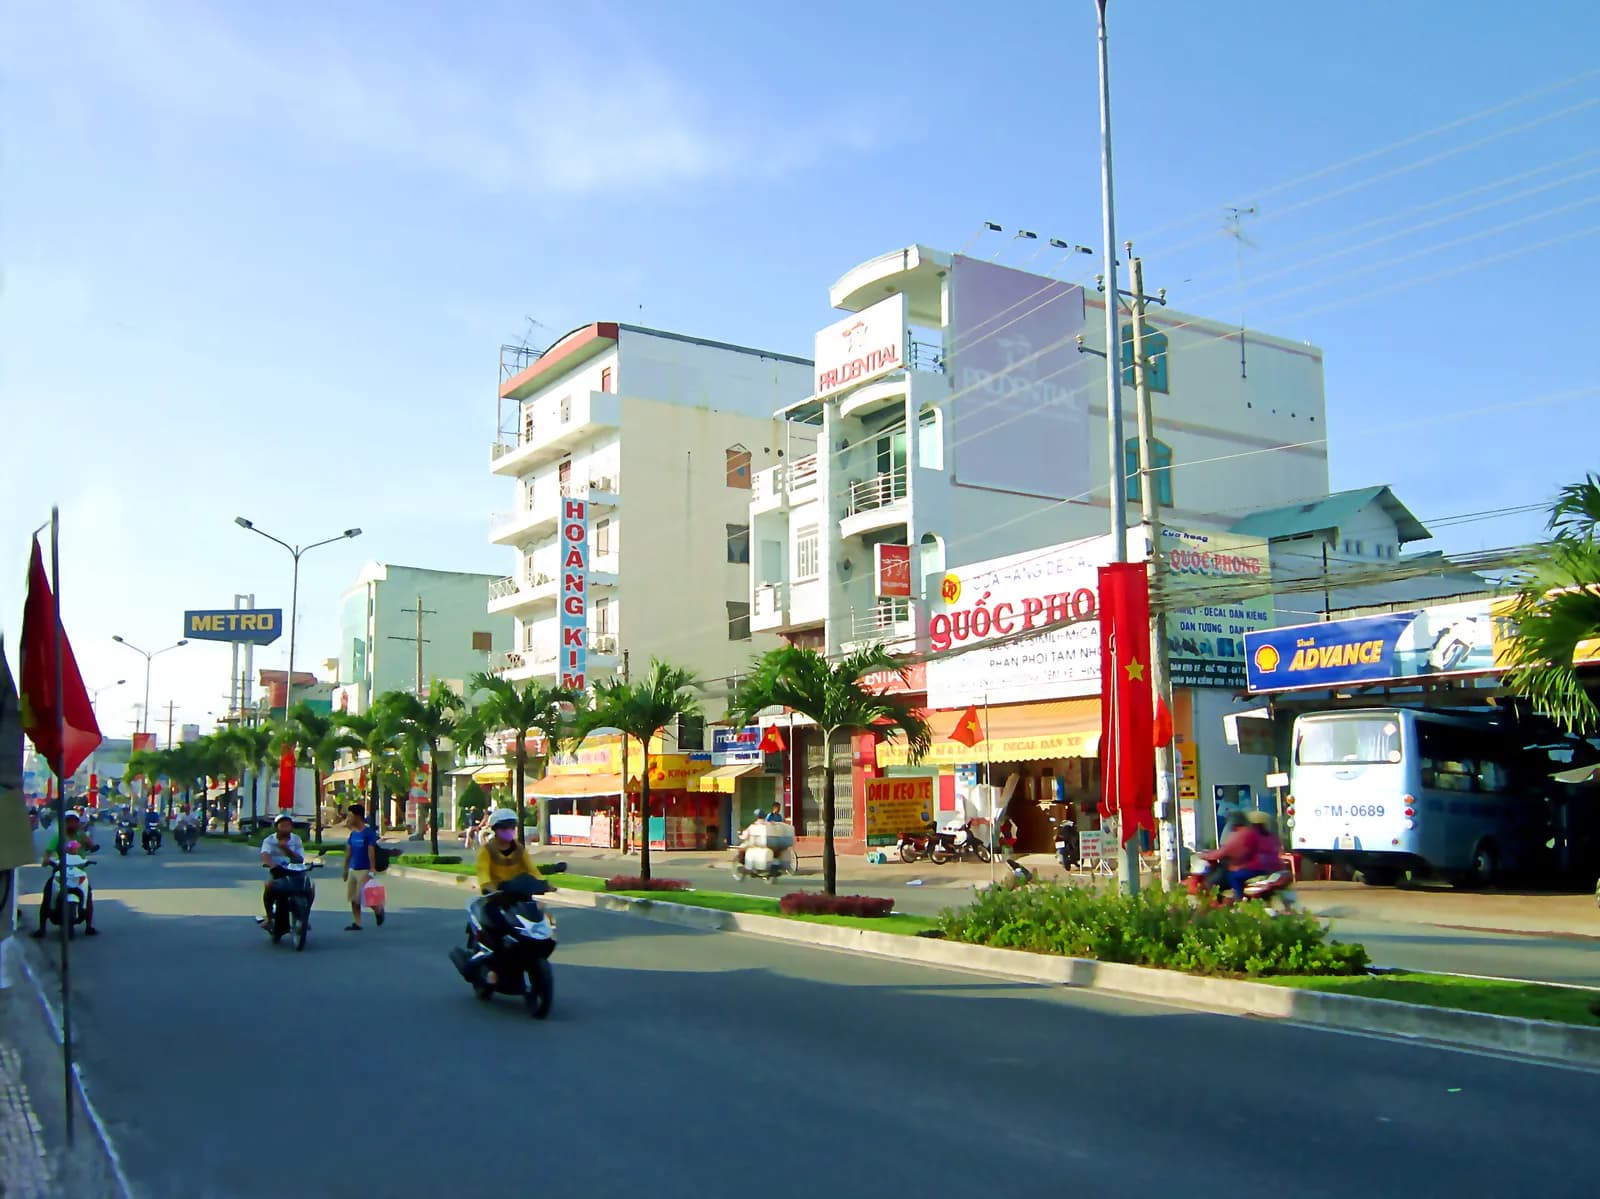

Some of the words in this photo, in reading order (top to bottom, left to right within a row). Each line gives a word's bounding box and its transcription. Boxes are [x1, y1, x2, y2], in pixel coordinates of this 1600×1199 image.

[819, 343, 899, 393] PRUDENTIAL
[564, 501, 585, 616] HOÀNG
[1213, 553, 1261, 575] PHONG
[191, 614, 274, 631] METRO
[929, 591, 1015, 652] QUỐC
[1288, 640, 1384, 672] ADVANCE
[1314, 804, 1385, 817] 67M-0689
